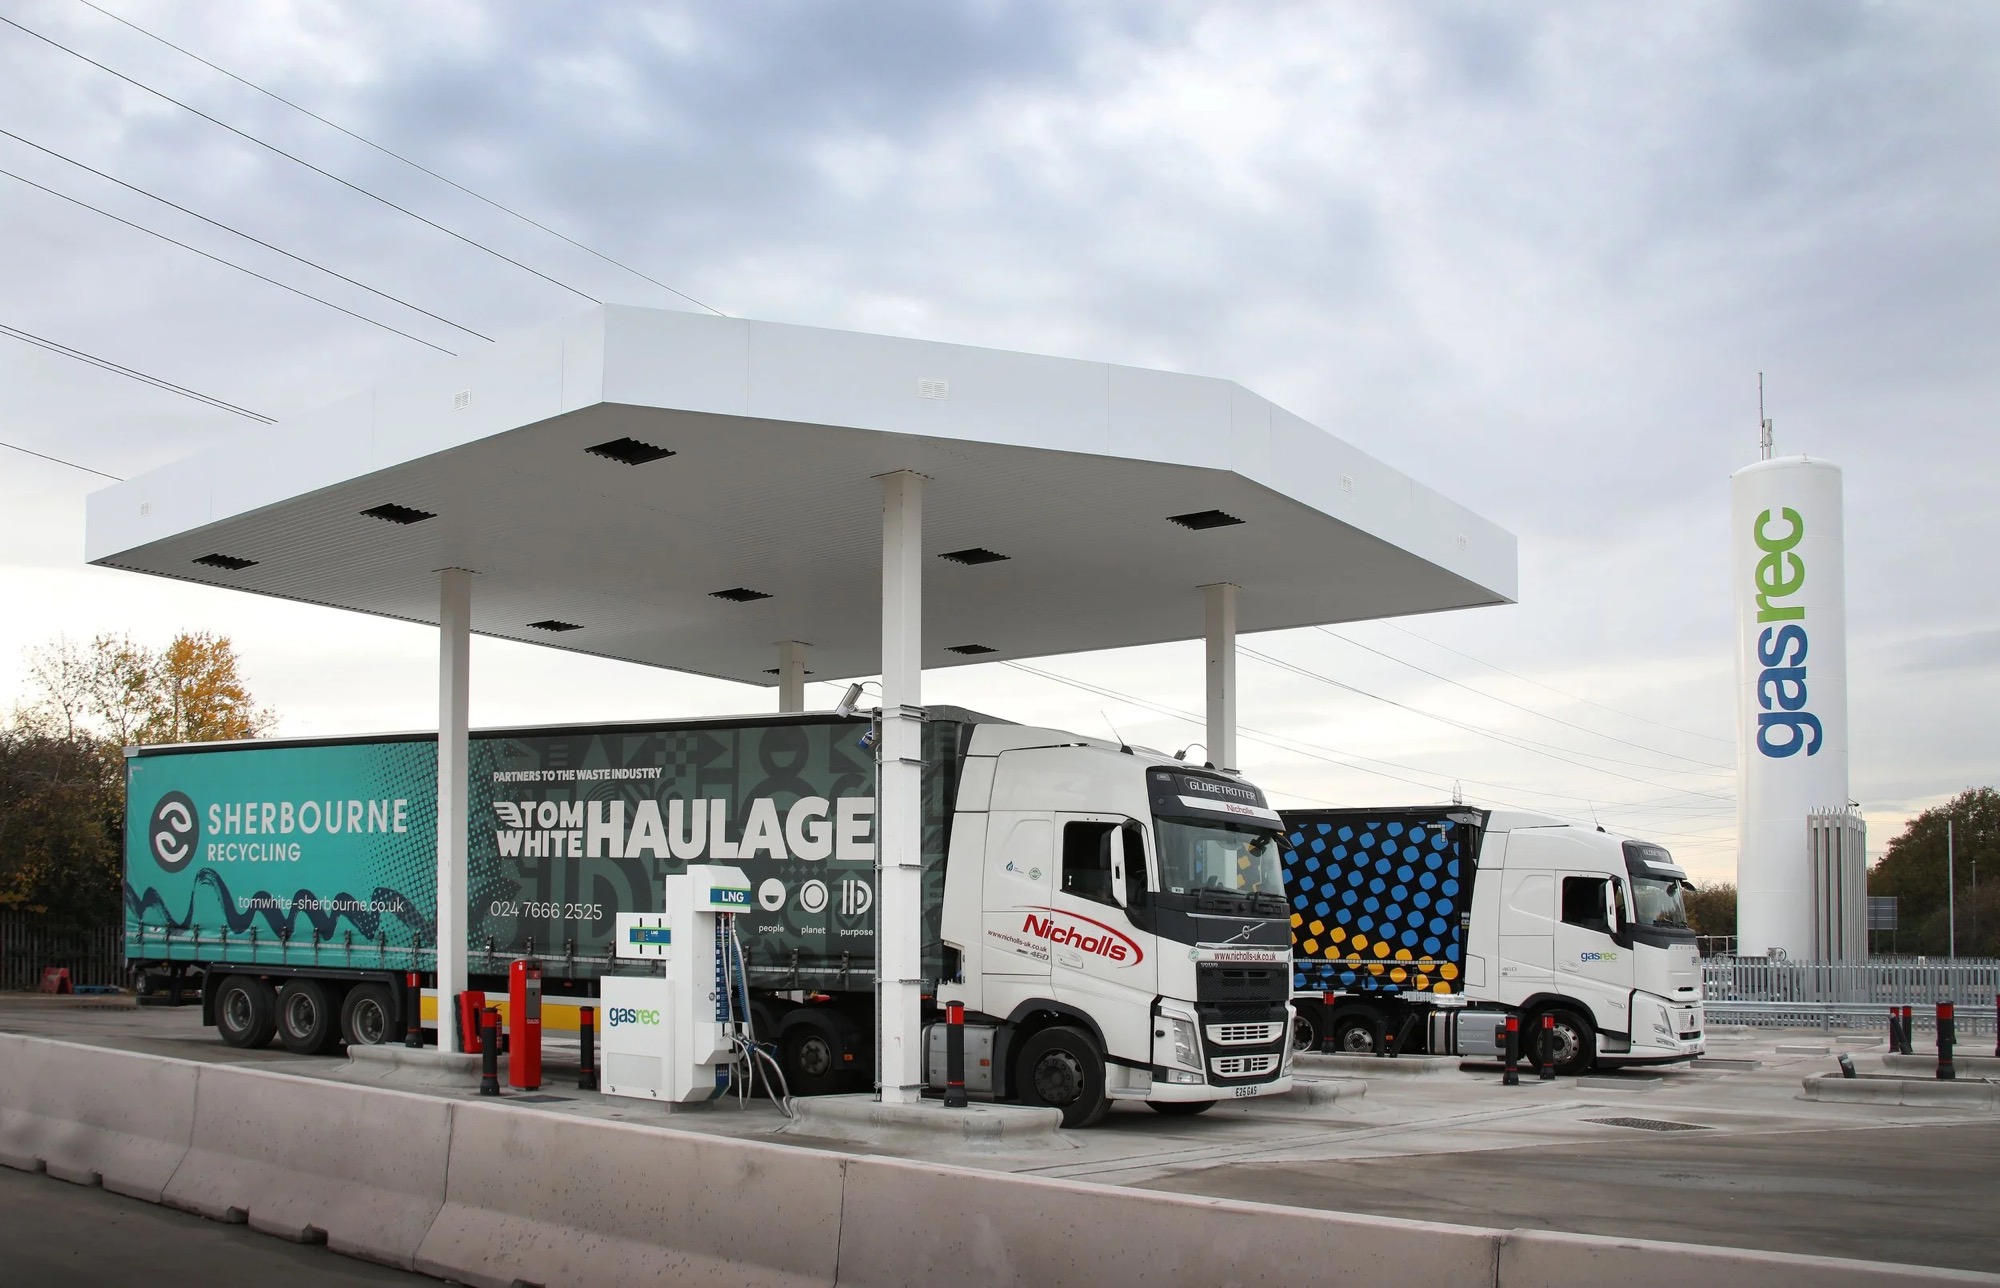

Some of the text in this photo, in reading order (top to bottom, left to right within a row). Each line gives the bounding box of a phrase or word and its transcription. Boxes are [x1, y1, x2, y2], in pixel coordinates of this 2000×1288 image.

[1753, 506, 1823, 759] gasrec
[493, 767, 663, 782] PARTNERS TO THE WASTE INDUSTRY
[1189, 781, 1256, 801] GLOBETROTTER
[207, 799, 409, 836] SHERBOURNE
[520, 800, 584, 829] TOM
[1225, 803, 1255, 816] Nicholls
[586, 795, 875, 861] HAULAGE
[207, 842, 302, 863] RECYCLING
[497, 830, 583, 858] WHITE
[238, 893, 405, 914] tomwhite-sherbourne.co.uk
[721, 890, 744, 903] LNG
[490, 901, 603, 921] 024 7666 2525
[758, 925, 785, 934] people
[801, 925, 826, 936] planet
[840, 927, 874, 938] purpose
[1022, 913, 1128, 962] Nicholls
[987, 929, 1048, 953] www.nicholls-uk.co.uk
[1213, 951, 1277, 961] www.nicholls-uk.co.uk
[1580, 951, 1617, 963] gasrec
[609, 1006, 660, 1028] gasrec
